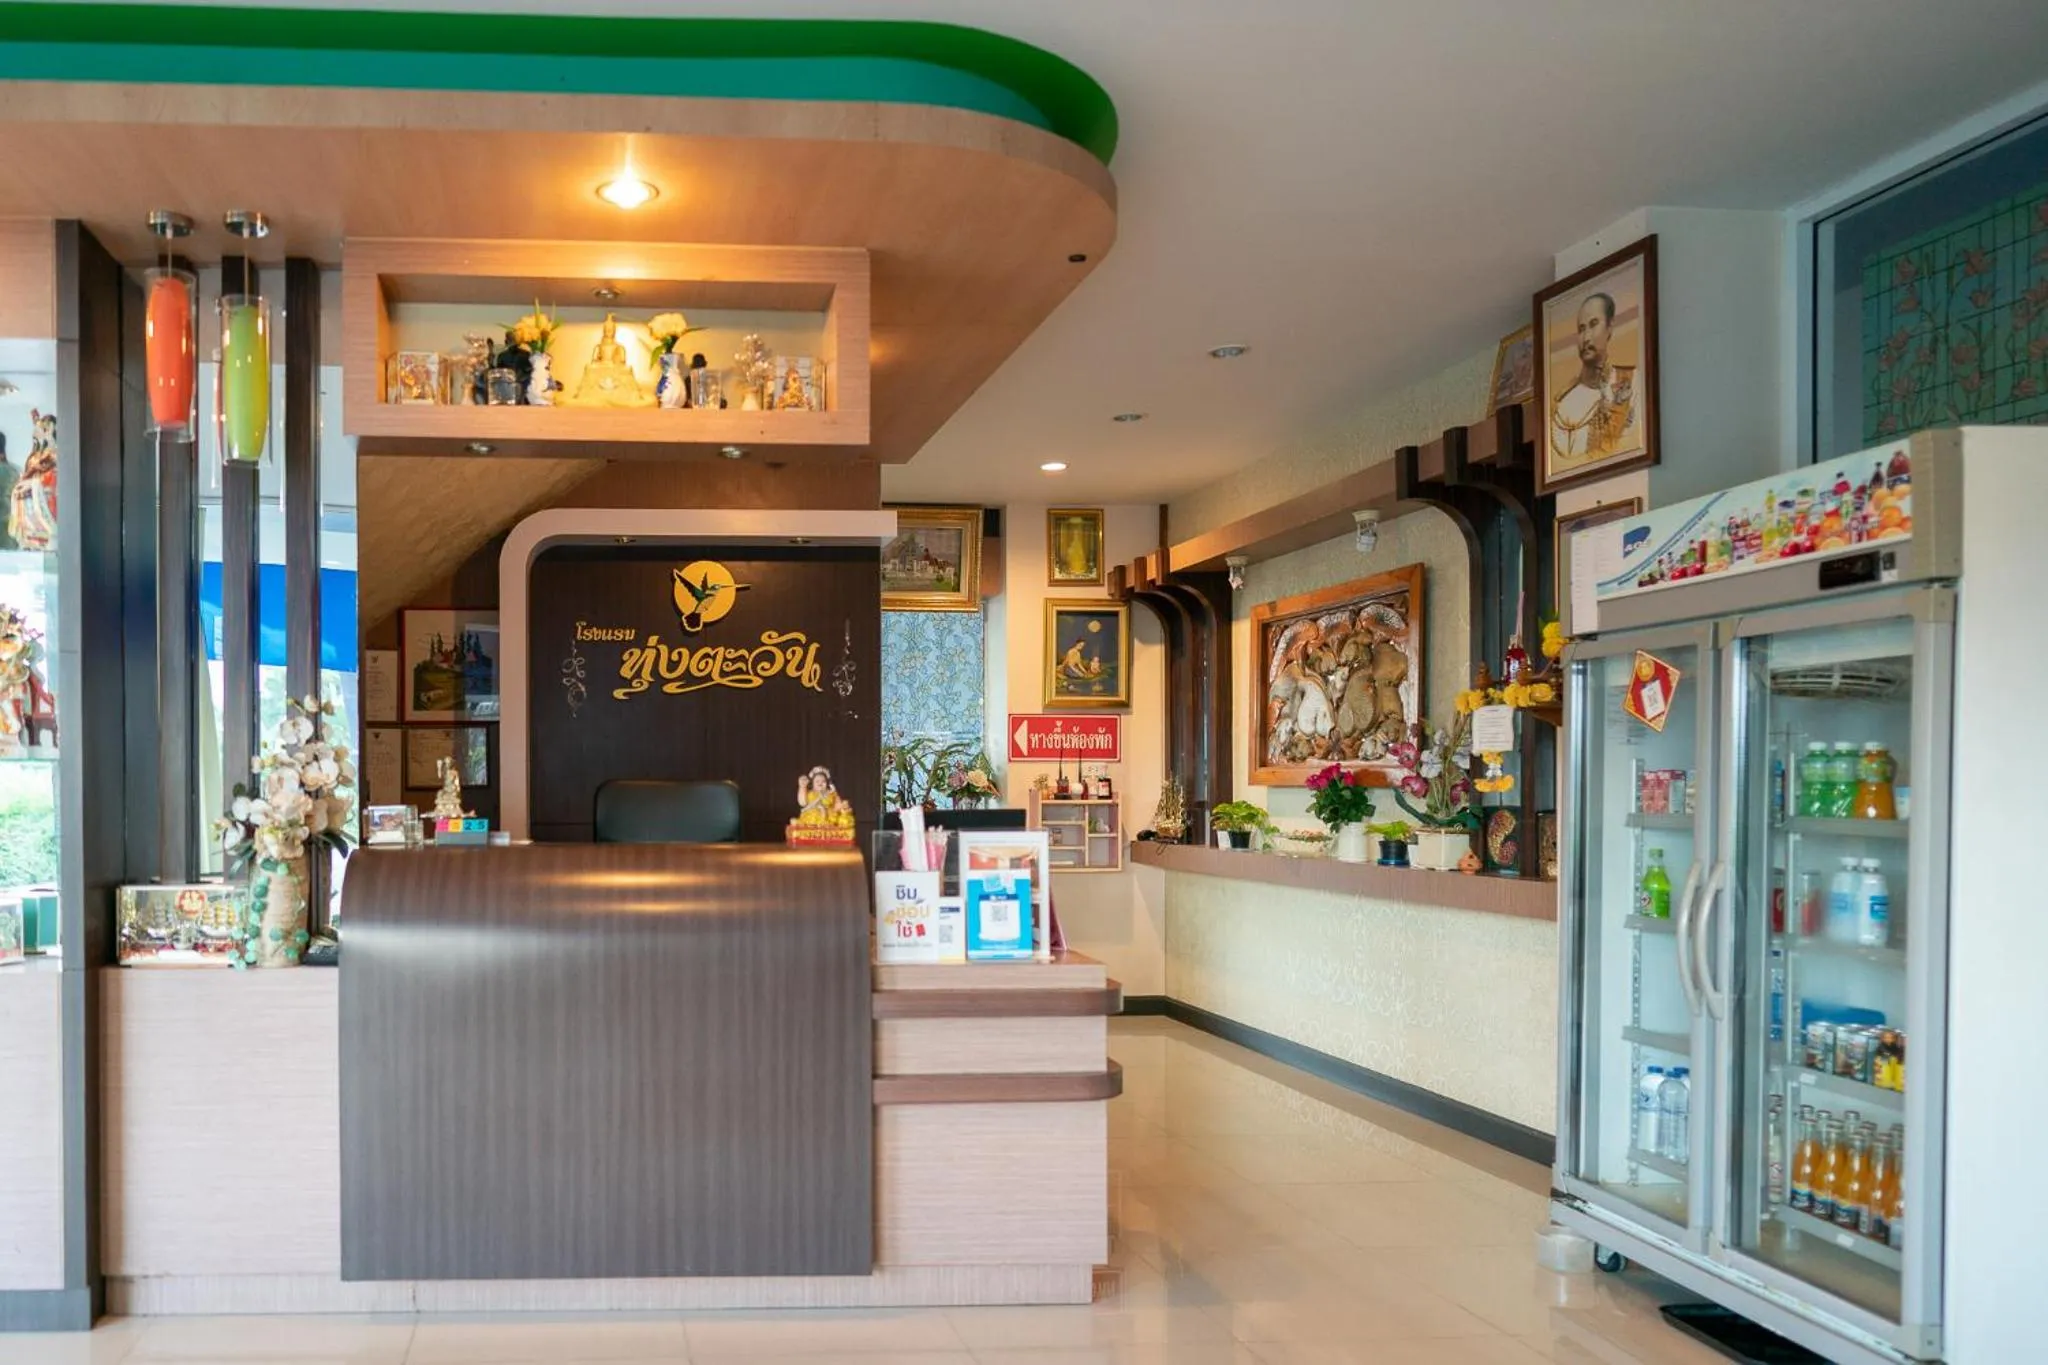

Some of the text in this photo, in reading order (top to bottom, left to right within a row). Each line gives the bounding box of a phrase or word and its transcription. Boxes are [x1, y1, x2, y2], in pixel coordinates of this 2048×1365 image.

[575, 620, 636, 642] โรงแรม
[612, 630, 824, 700] ทุ่งตะวัน
[1029, 720, 1113, 750] ทางขึ้นห้องพัก
